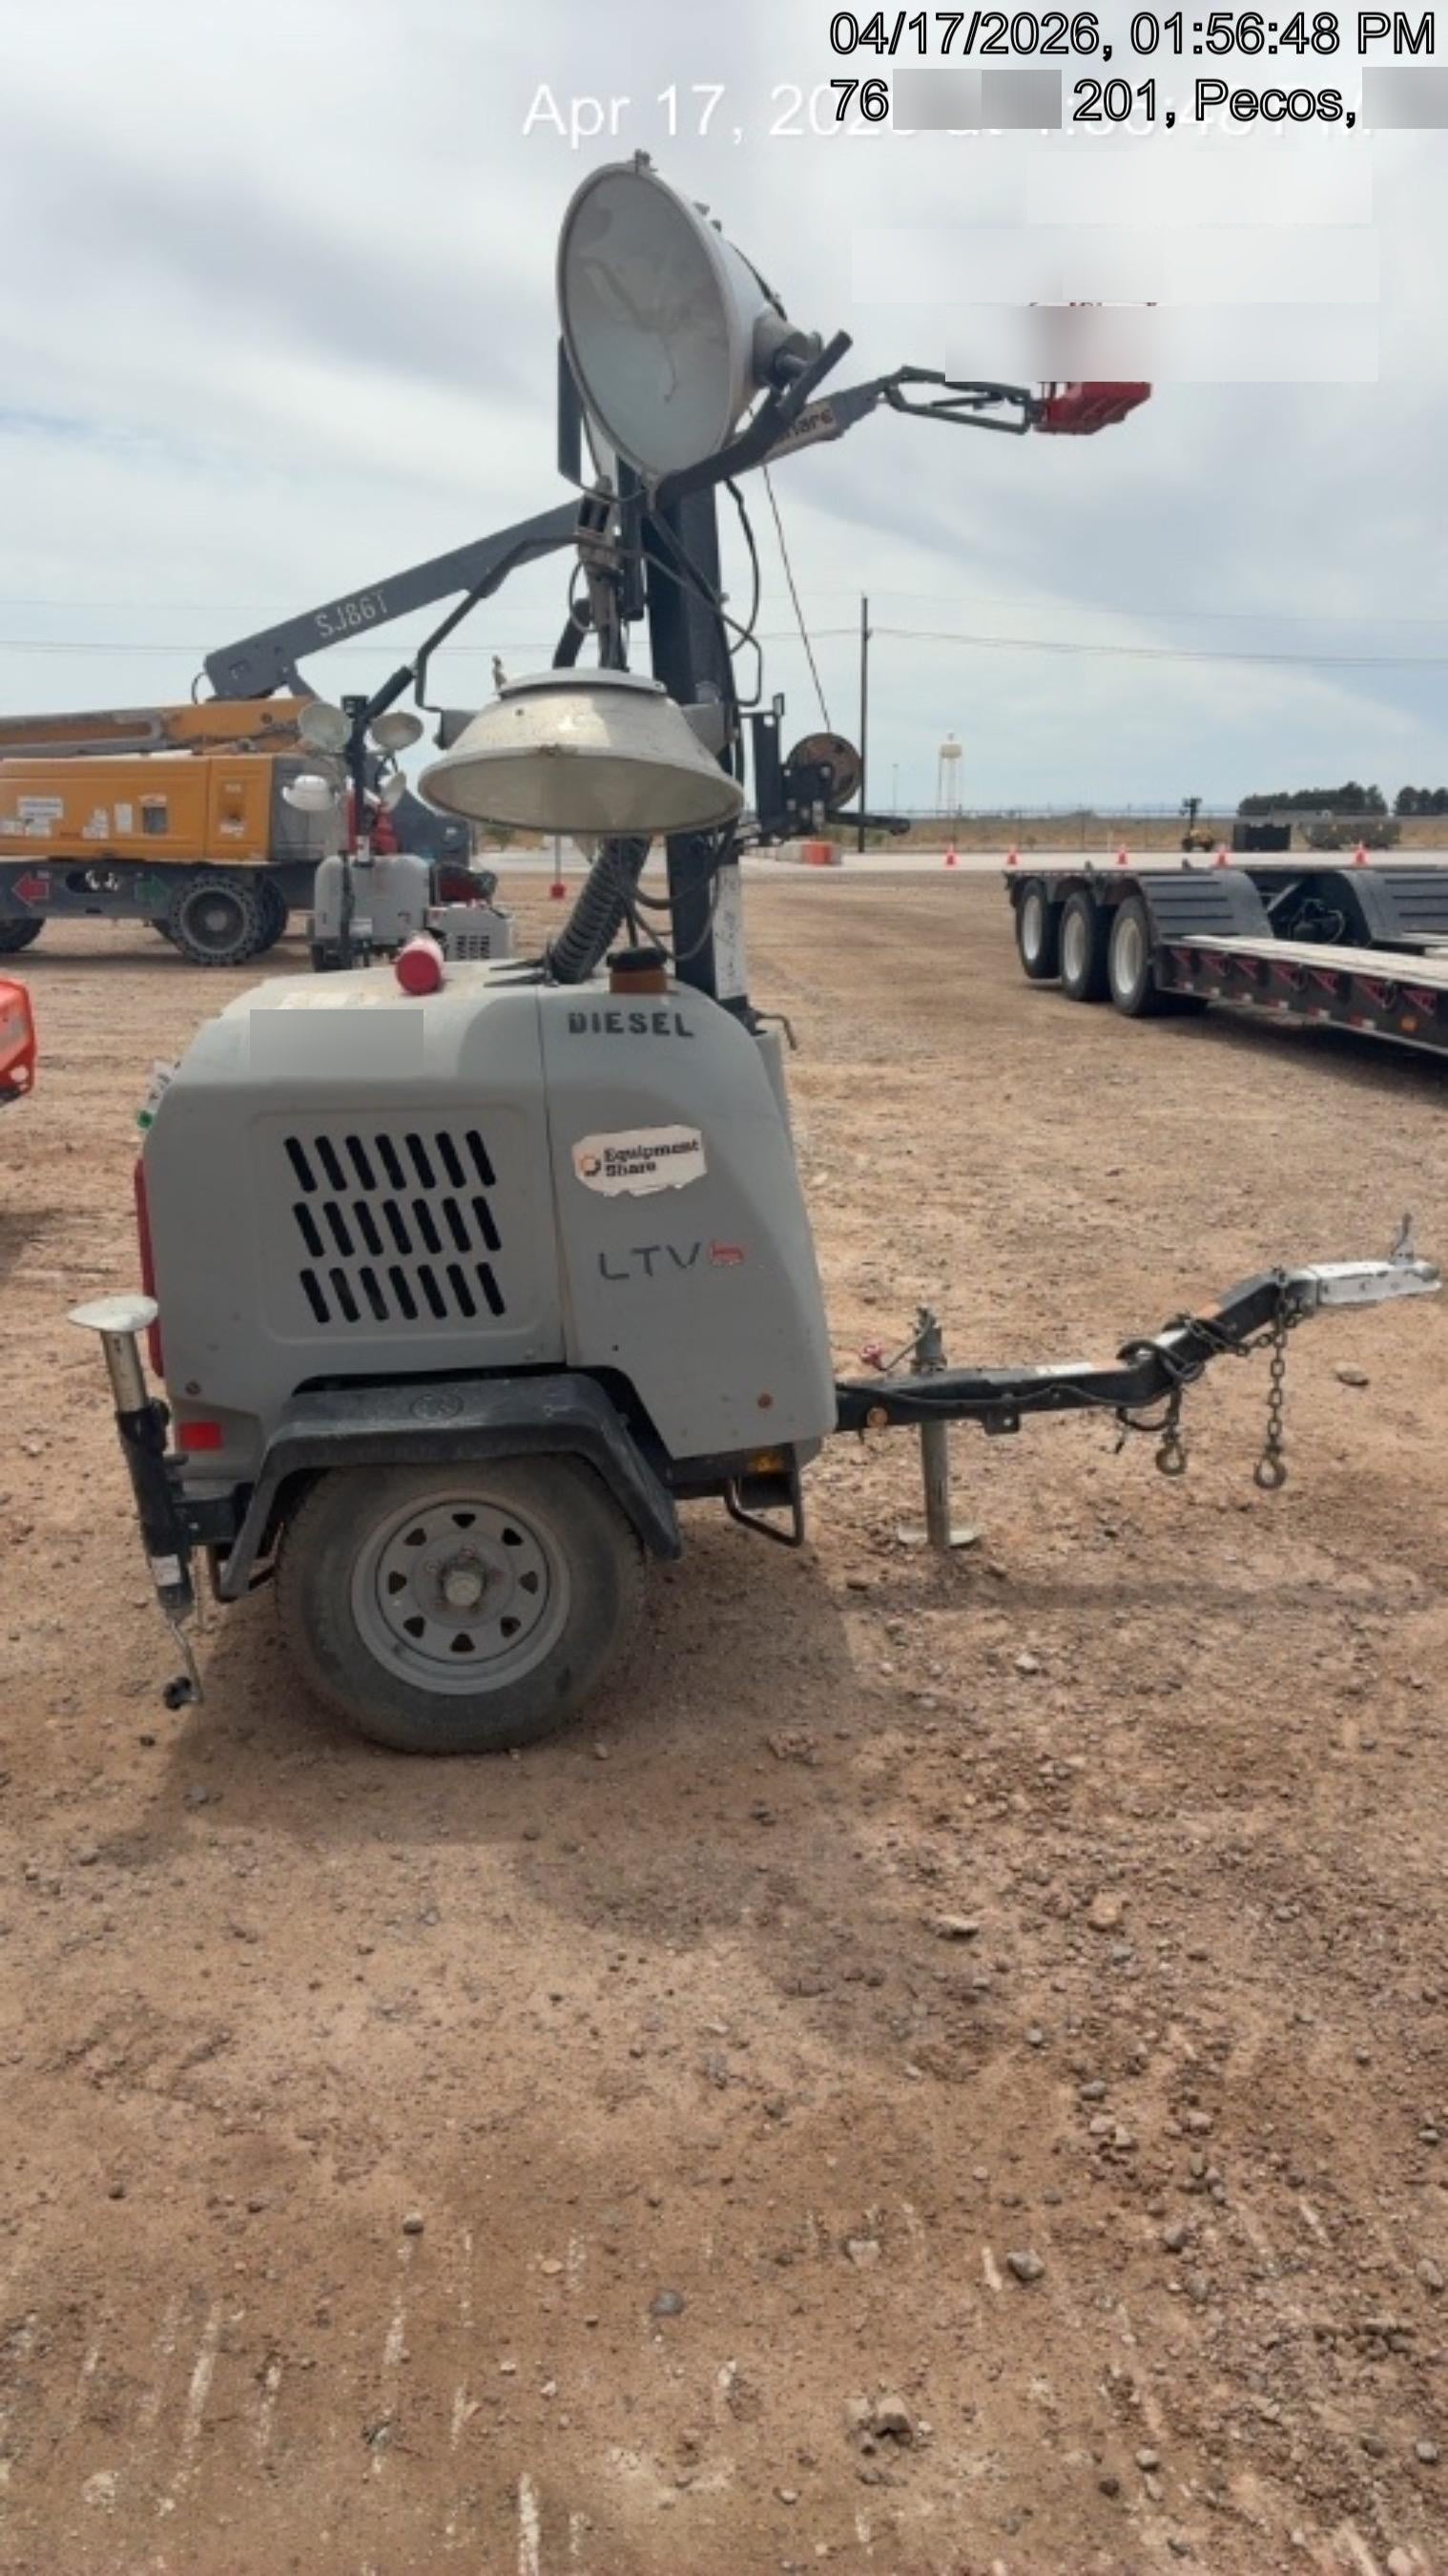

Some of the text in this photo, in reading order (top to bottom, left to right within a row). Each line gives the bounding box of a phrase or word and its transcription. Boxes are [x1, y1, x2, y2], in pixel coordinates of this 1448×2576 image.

[568, 1011, 695, 1037] DIESEL
[604, 1138, 699, 1163] Equipment
[605, 1161, 656, 1177] Share
